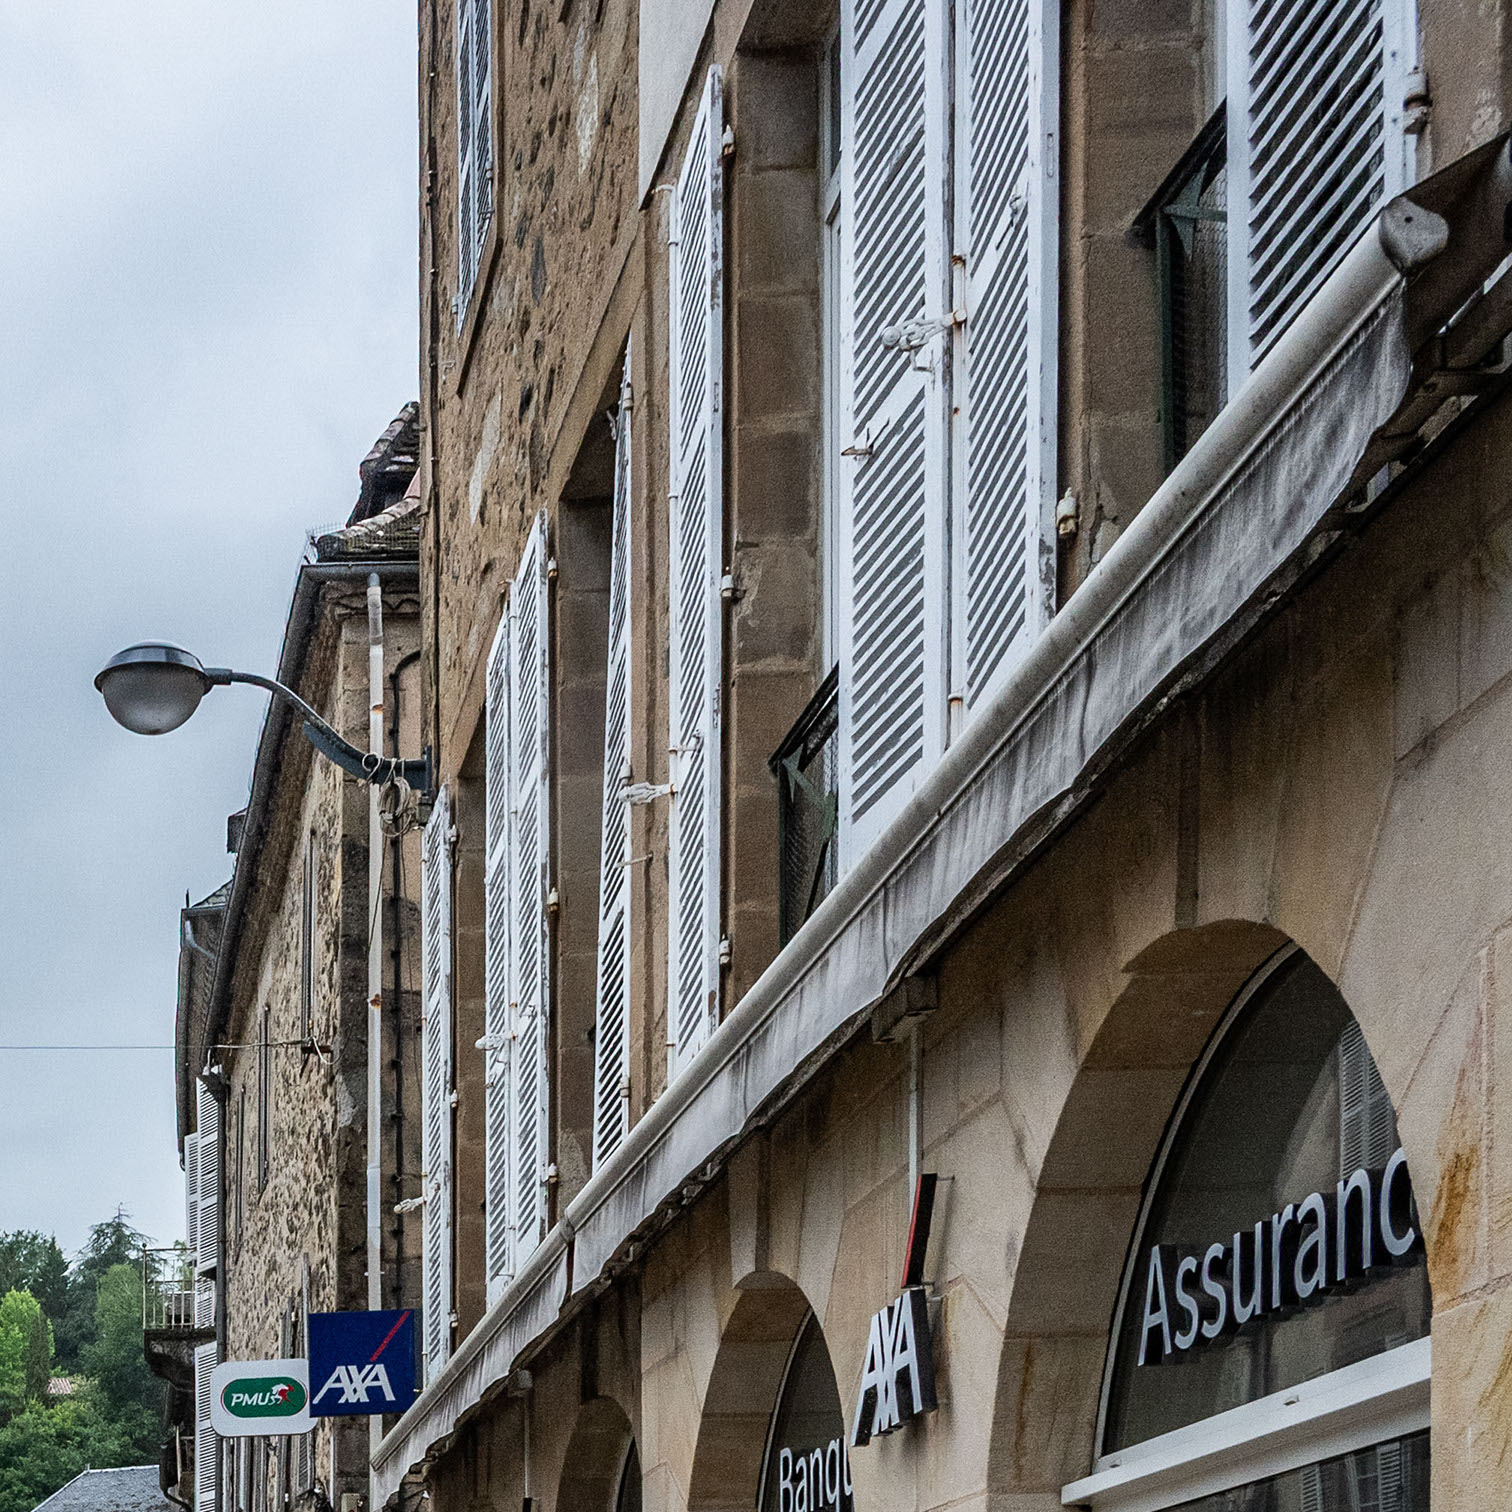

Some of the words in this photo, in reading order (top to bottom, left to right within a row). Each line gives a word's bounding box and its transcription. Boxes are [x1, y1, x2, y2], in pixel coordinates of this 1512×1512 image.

[1137, 1147, 1416, 1366] Assuranc
[231, 1392, 270, 1407] PMU
[312, 1364, 396, 1404] AXA
[851, 1289, 923, 1447] AXA
